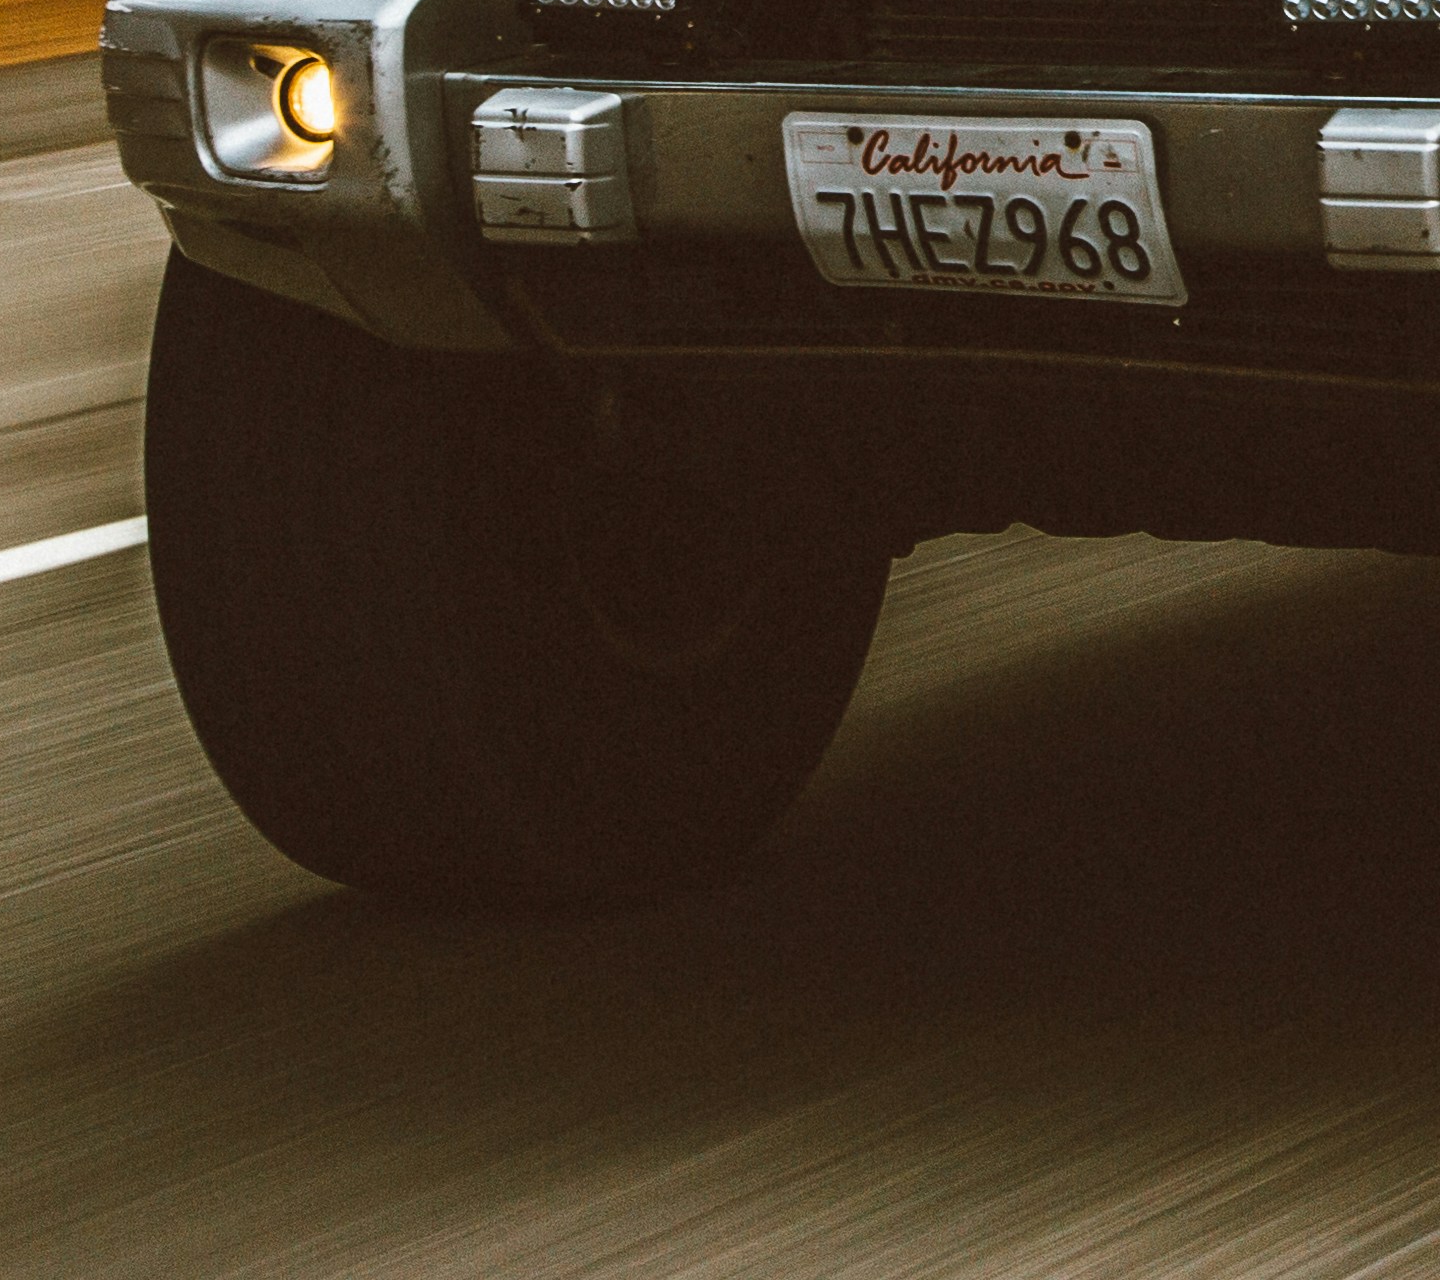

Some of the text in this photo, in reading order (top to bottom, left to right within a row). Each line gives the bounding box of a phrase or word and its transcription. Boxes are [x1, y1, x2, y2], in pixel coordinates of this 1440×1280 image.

[861, 129, 1090, 190] California
[816, 191, 1153, 281] 7HEZ968
[911, 273, 1097, 293] dmv.ca.gov
